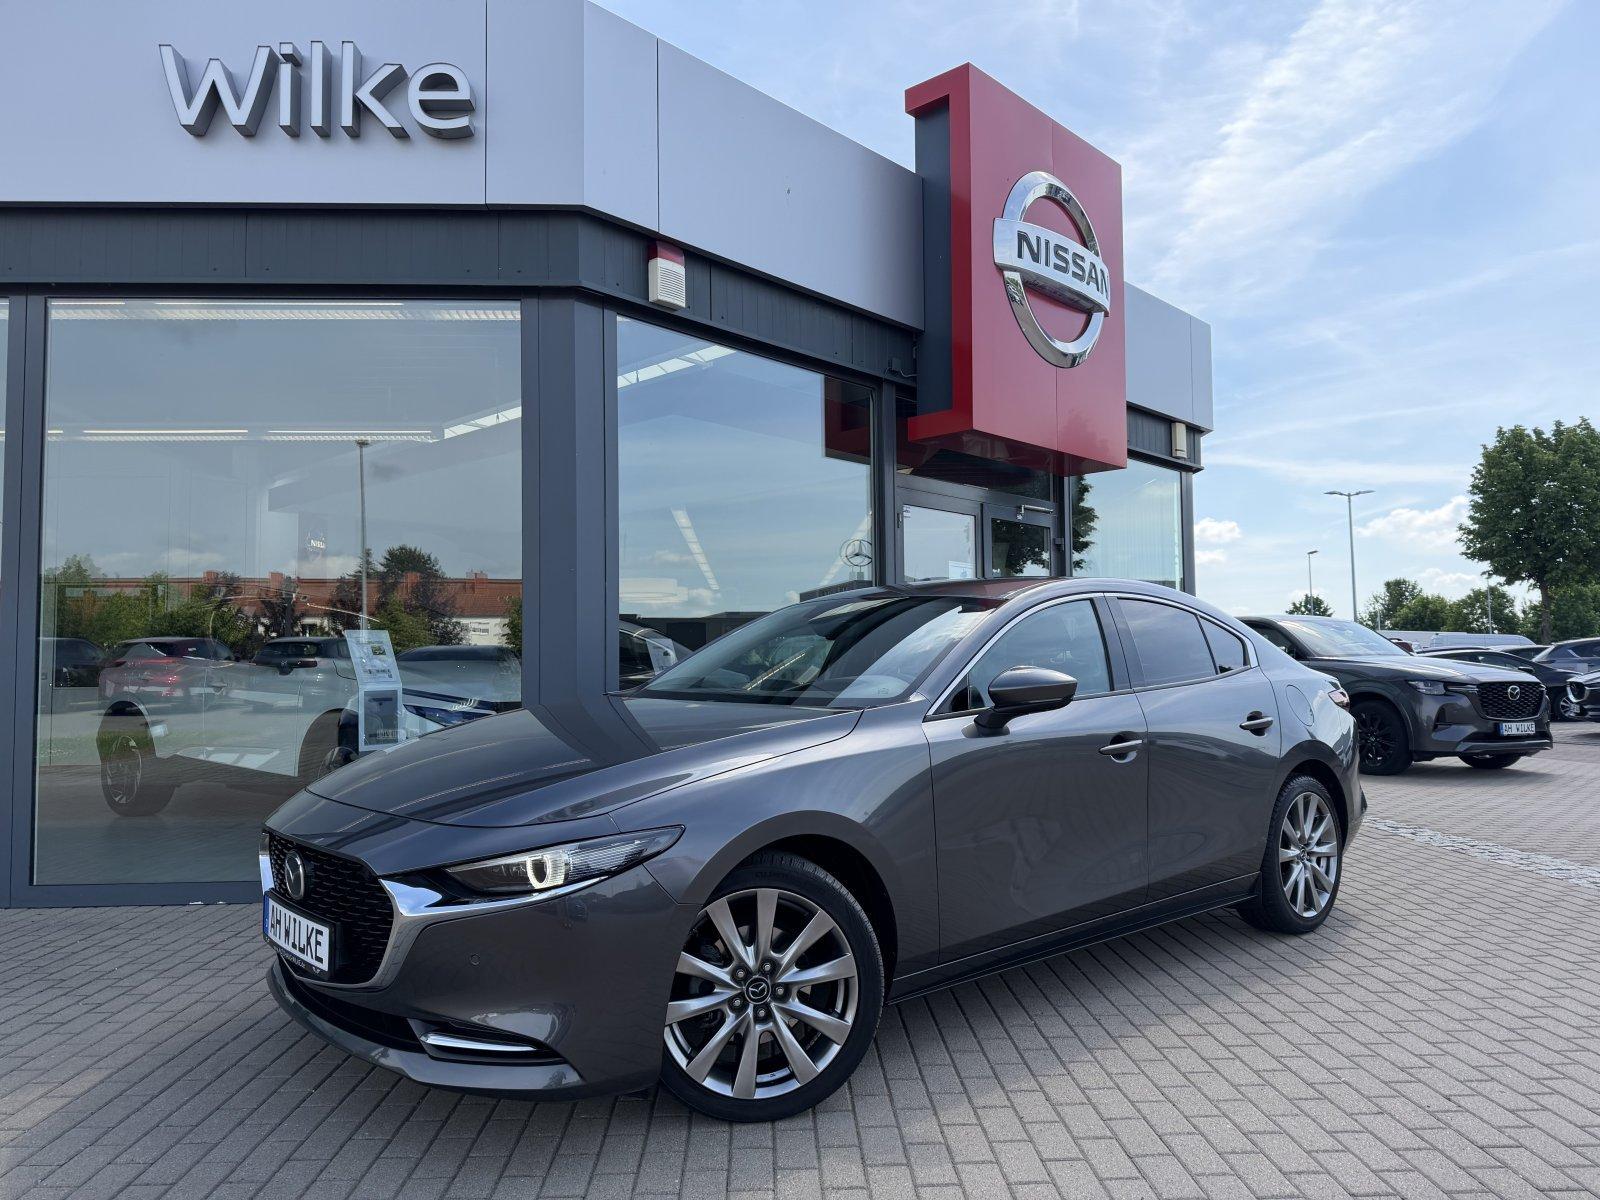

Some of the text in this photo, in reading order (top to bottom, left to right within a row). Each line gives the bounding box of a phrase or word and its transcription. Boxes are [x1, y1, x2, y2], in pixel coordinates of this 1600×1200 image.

[158, 40, 476, 138] Wilke
[1017, 230, 1109, 301] NISSAN
[270, 905, 281, 940] AH
[284, 913, 323, 965] WILKE
